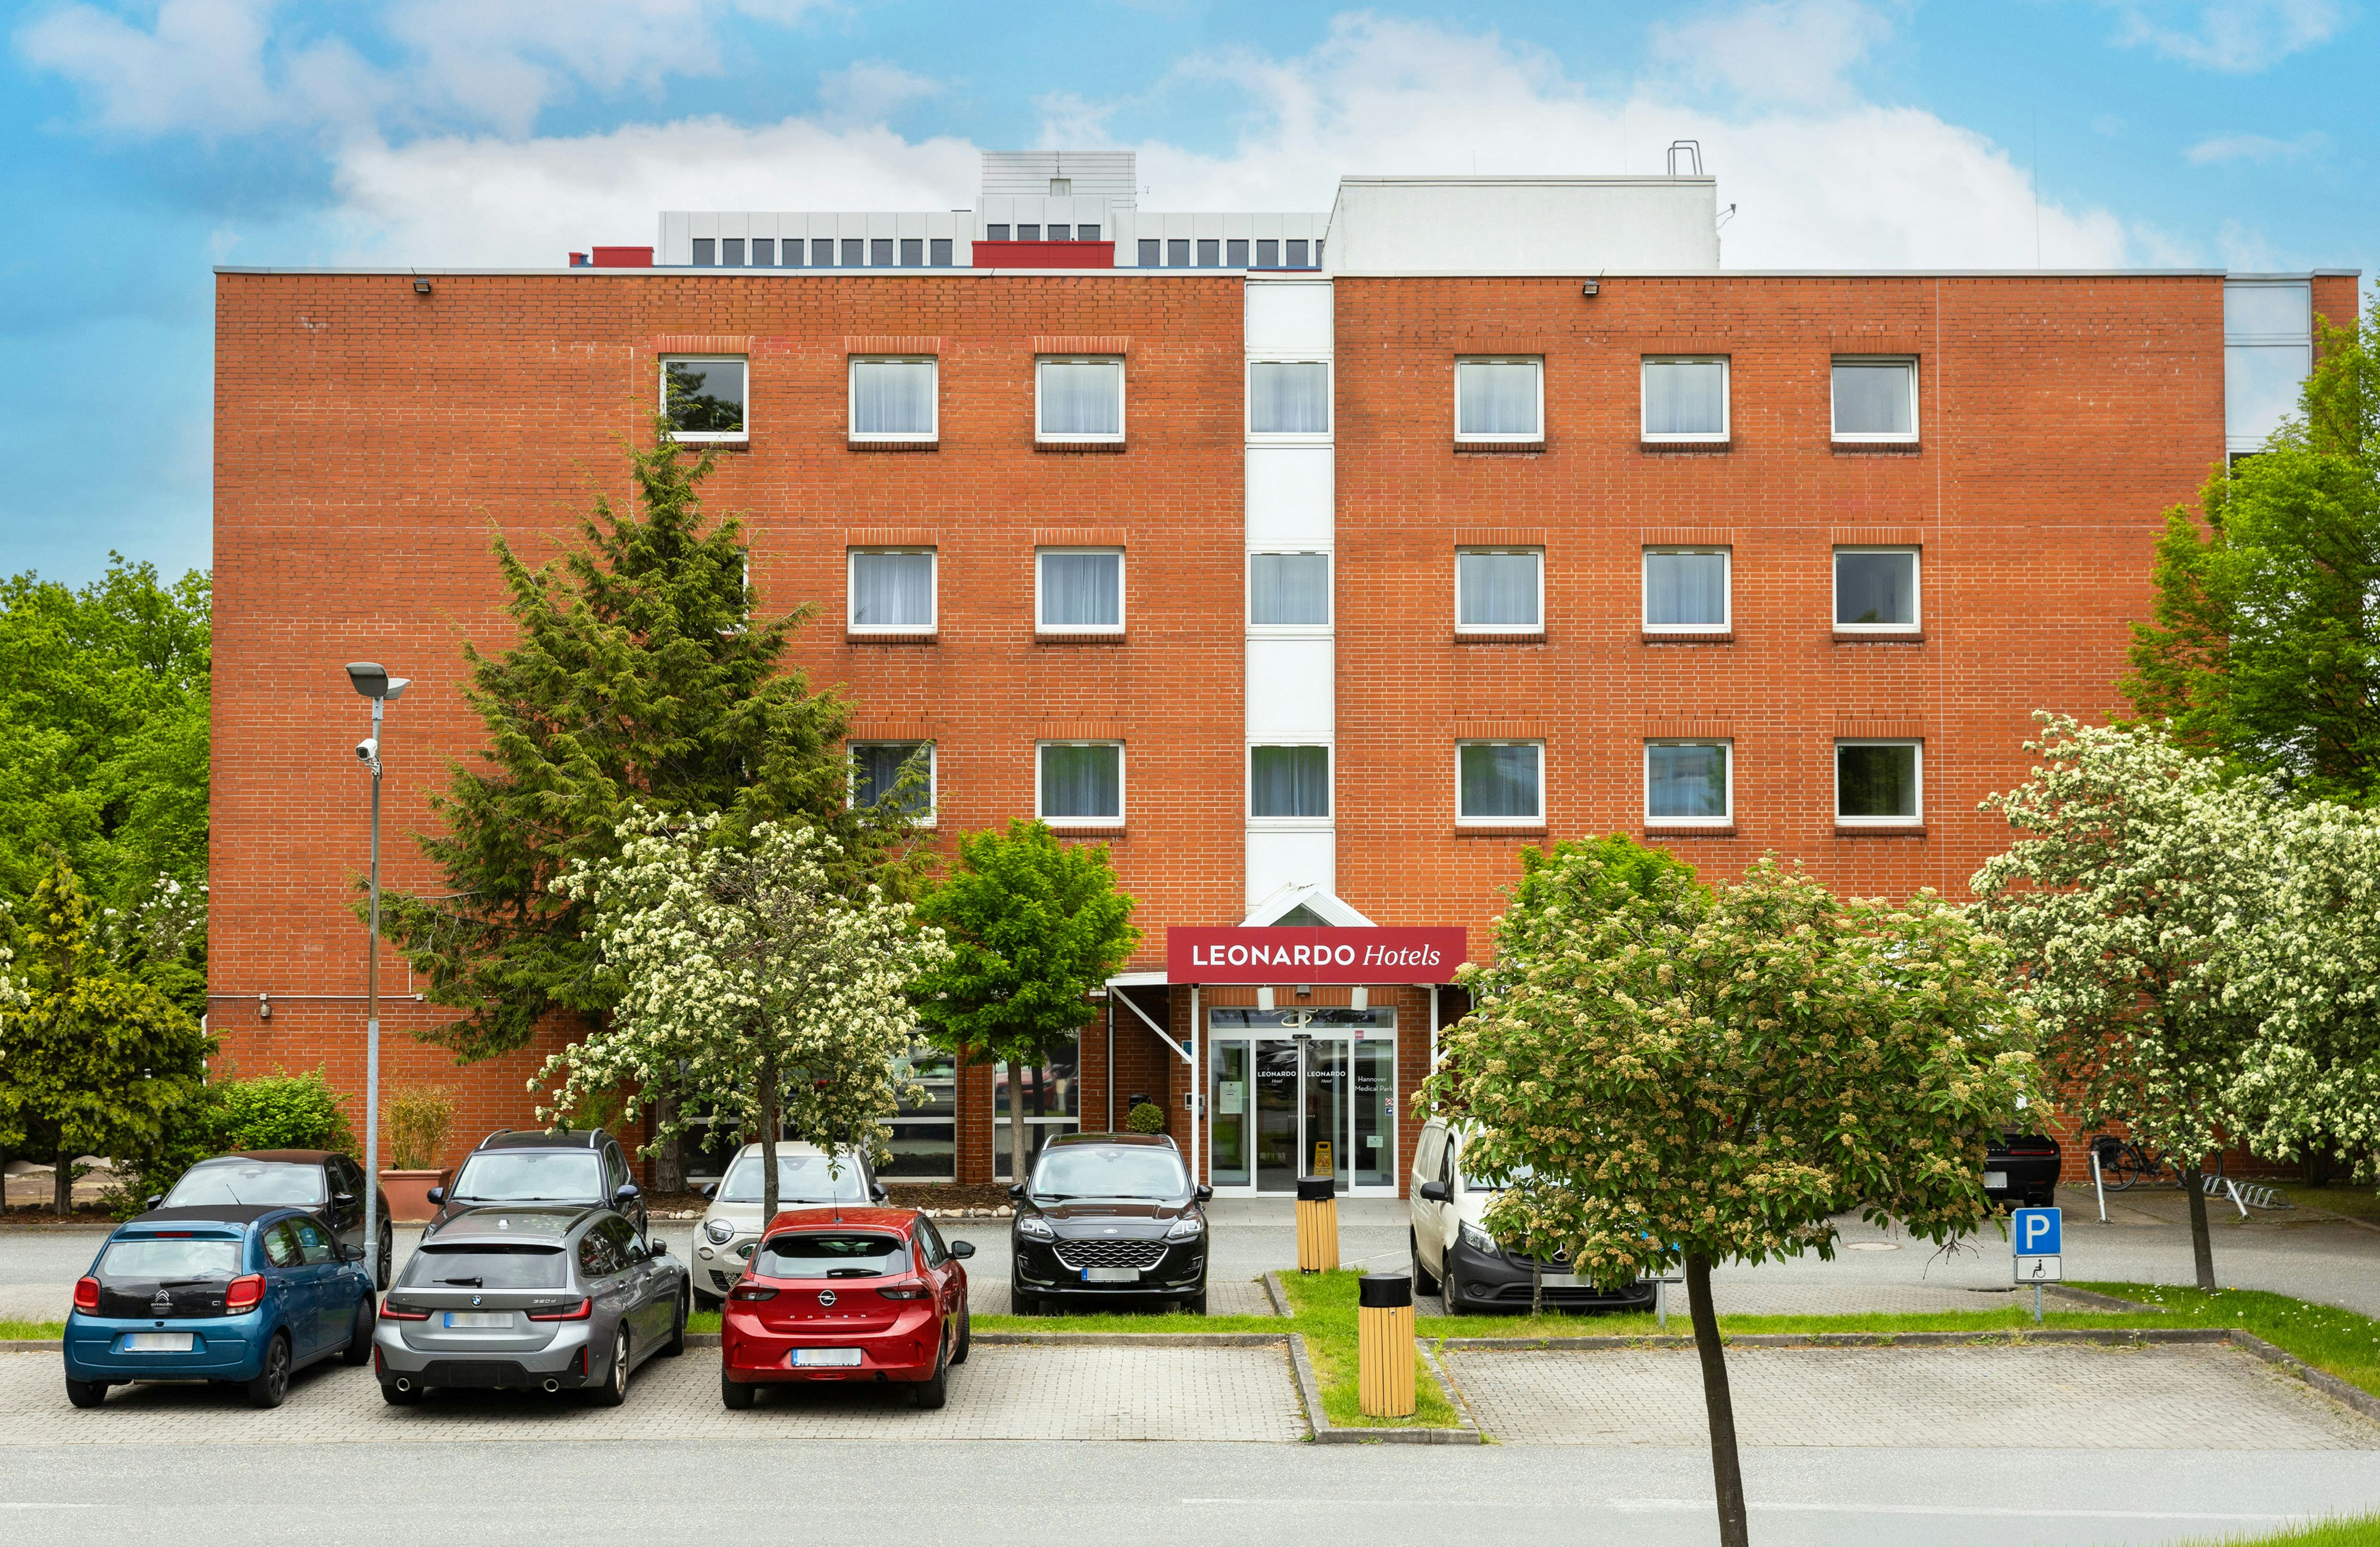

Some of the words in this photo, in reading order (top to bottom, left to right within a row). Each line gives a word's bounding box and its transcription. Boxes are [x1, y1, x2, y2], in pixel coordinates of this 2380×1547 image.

[1193, 945, 1355, 966] LEONARDO
[1363, 944, 1440, 966] Hotels
[2027, 1215, 2050, 1249] P
